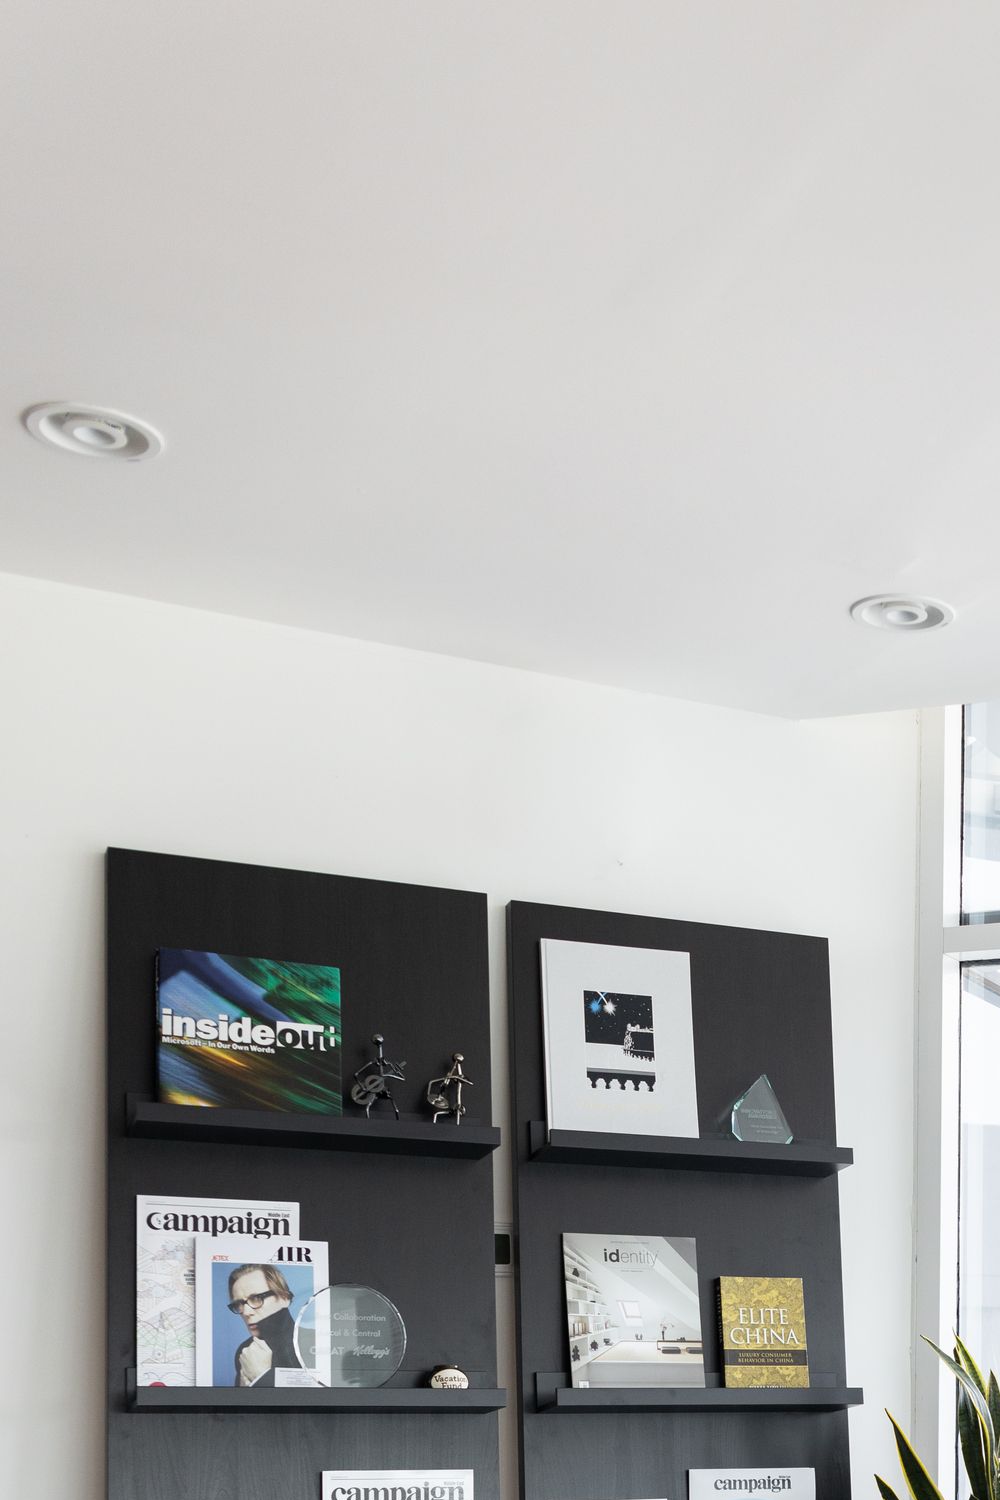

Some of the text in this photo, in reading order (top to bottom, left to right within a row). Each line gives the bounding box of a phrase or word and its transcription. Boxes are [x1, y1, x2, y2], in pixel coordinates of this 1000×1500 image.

[232, 1043, 249, 1051] Own
[250, 1045, 275, 1054] Words
[146, 1211, 291, 1240] campaign
[267, 1246, 314, 1263] AIR
[603, 1248, 659, 1268] identity
[333, 1312, 386, 1322] Collaboration
[738, 1307, 789, 1325] ELITE
[352, 1329, 381, 1337] Central
[730, 1327, 799, 1345] CHINA
[353, 1344, 391, 1359] Kellogg's
[713, 1475, 792, 1493] campaign
